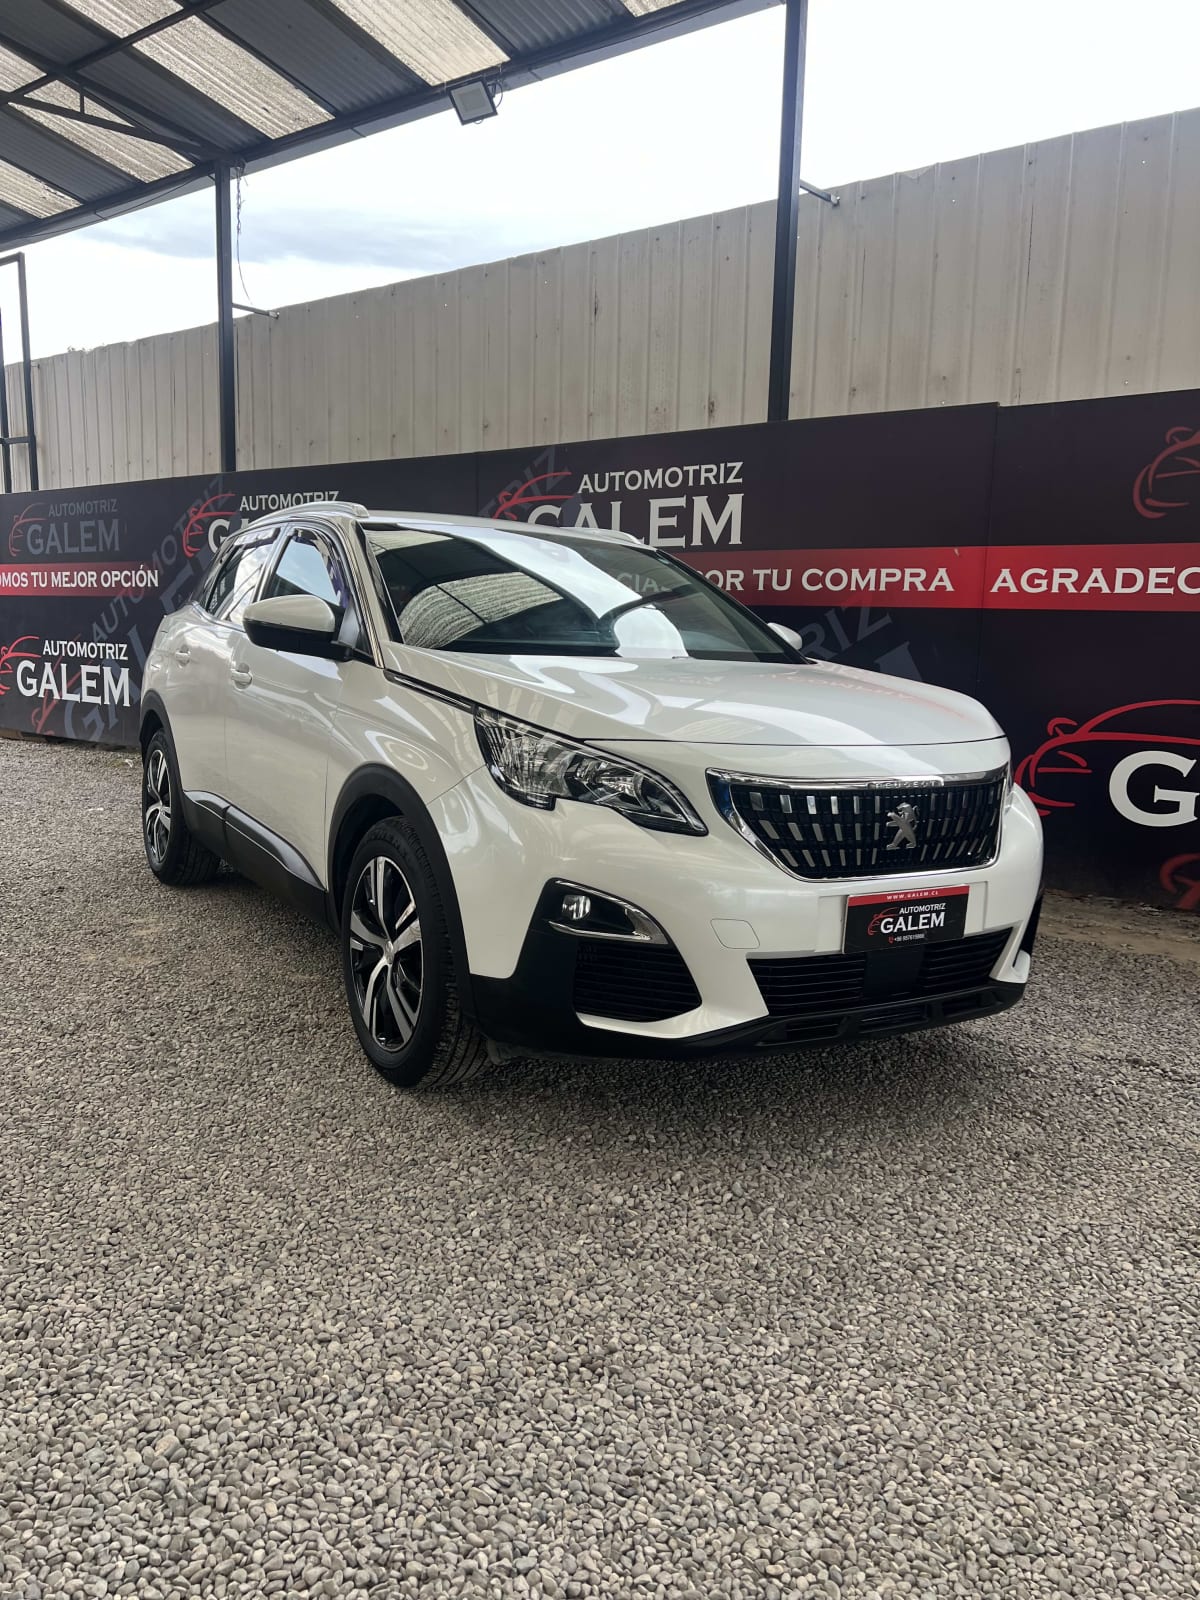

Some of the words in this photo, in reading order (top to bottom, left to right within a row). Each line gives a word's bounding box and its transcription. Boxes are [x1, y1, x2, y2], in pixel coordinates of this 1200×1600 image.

[578, 461, 743, 495] AUTOMOTRIZ
[48, 498, 118, 518] AUTOMOTRIZ
[27, 518, 120, 556] GALEM
[0, 571, 29, 588] MOS
[31, 571, 48, 588] TU
[51, 569, 97, 588] MEJOR
[100, 564, 159, 588] OPCIÓN
[696, 569, 745, 591] OR
[753, 568, 793, 591] TU
[801, 567, 955, 592] COMPRA
[42, 639, 129, 661] AUTOMOTRIZ
[16, 660, 131, 707] GALEM
[899, 903, 946, 915] AUTOMOTRIZ
[880, 912, 945, 934] GALEM
